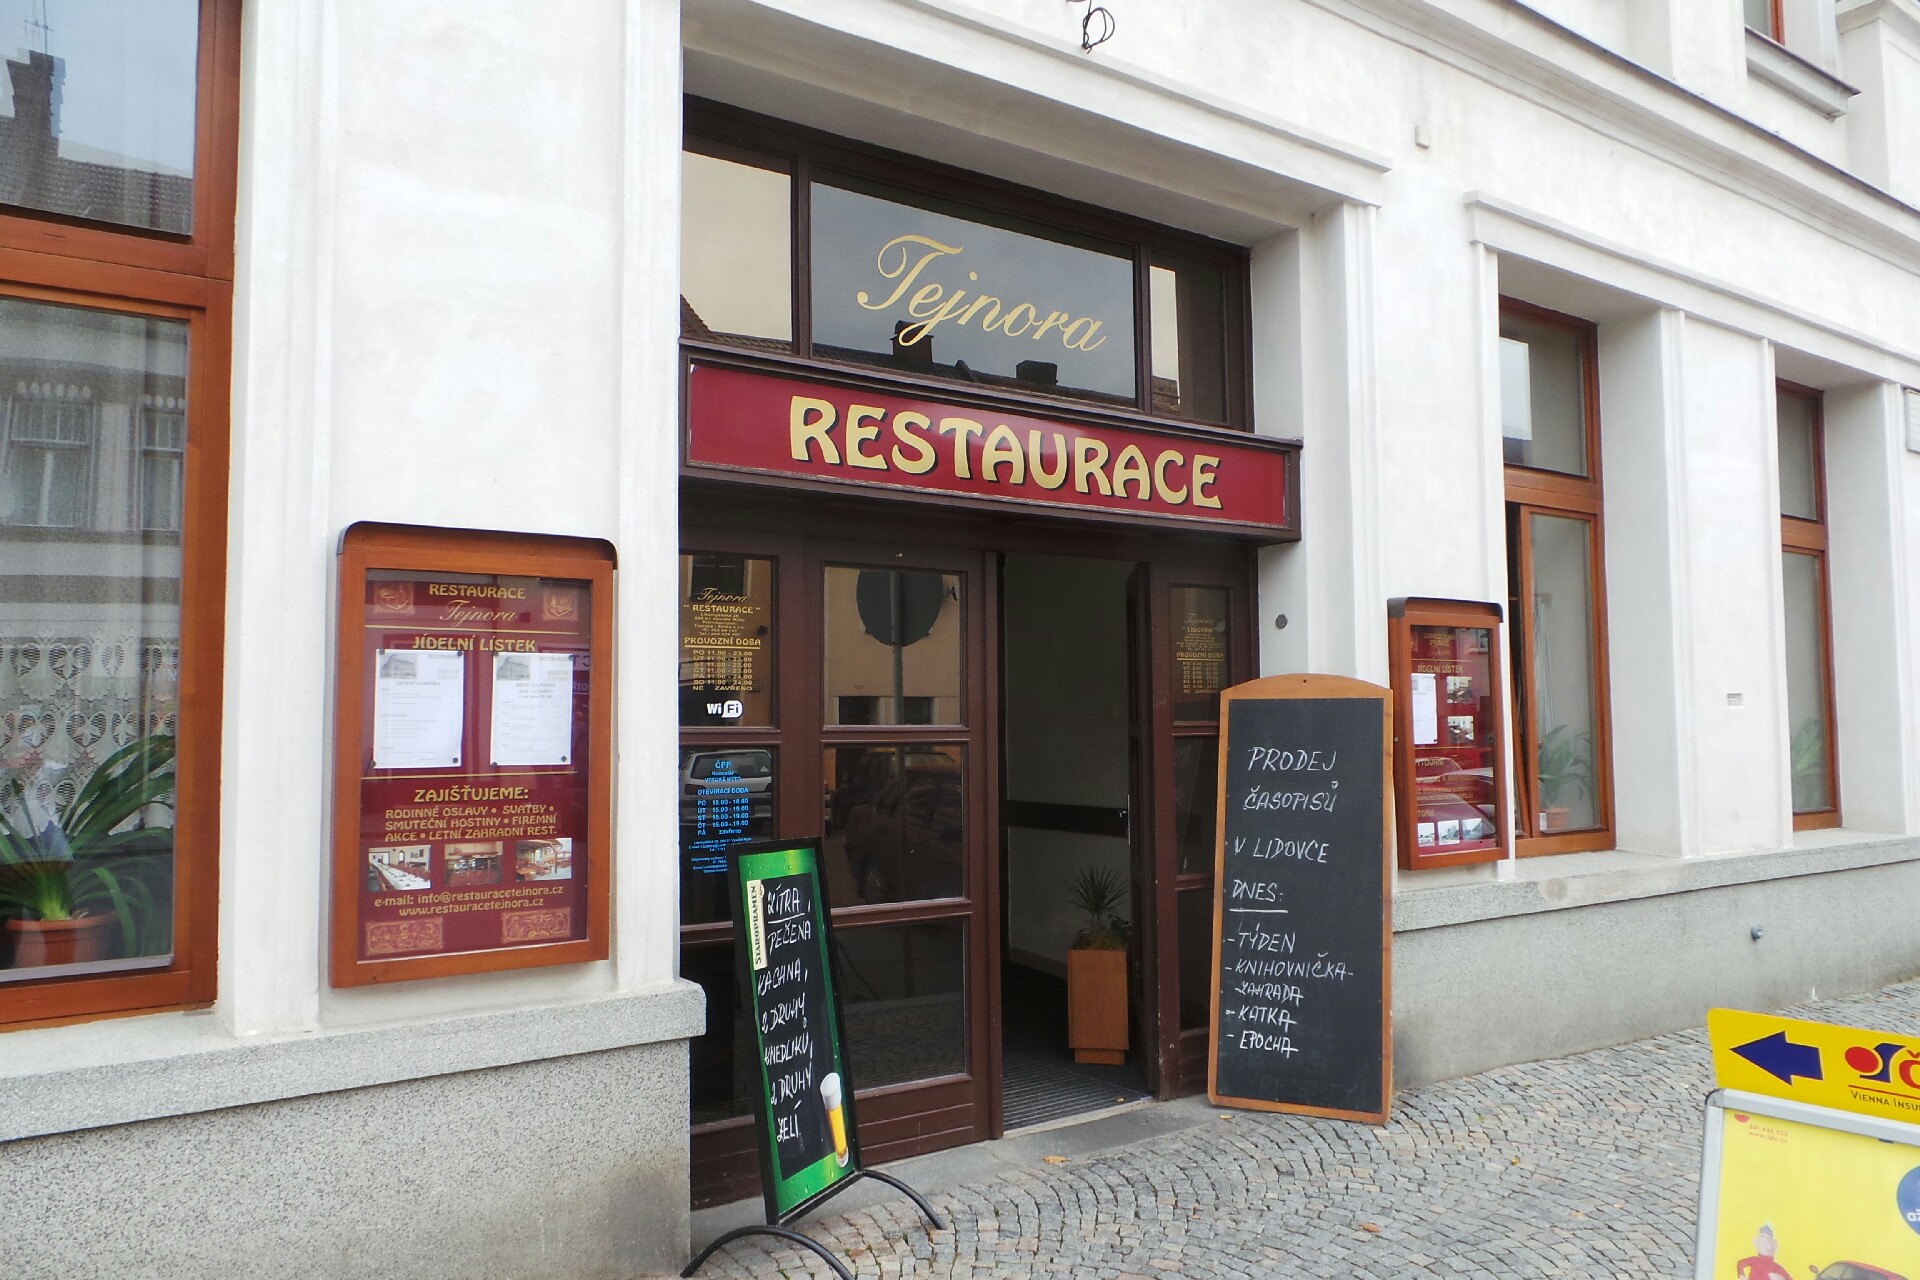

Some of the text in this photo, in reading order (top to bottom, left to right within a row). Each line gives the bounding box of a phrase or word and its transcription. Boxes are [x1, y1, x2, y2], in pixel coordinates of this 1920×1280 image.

[856, 234, 1107, 352] Tejnora
[789, 395, 1223, 510] RESTAURACE
[429, 583, 526, 599] RESTAURACE
[697, 587, 748, 605] Tejnora
[439, 599, 518, 627] Tejnora
[692, 604, 754, 614] RESTAURACE
[412, 634, 536, 653] JÍDELNÍ LÍSTEK
[684, 636, 761, 646] PROVOZNÍ DOBA
[1247, 746, 1337, 772] PRODEJ
[413, 784, 529, 803] ZAJIŠŤUJEME:
[1243, 781, 1339, 813] ČASOPISŮ
[384, 812, 557, 831] SMUTEČNÍ HOSTINY FIREMNÍ
[385, 804, 547, 819] RODINNÉ OSLAVY SVATBY
[384, 824, 557, 842] AKCE LETNÍ ZAHRADNÍ REST.
[1234, 835, 1330, 863] V LIDOVCE
[374, 885, 564, 907] e-mail: info@restauracetejnora.cz
[1232, 879, 1284, 902] DNES:
[399, 897, 544, 917] www.restauracetejnora.cz
[750, 886, 762, 965] STAROPRAMEN
[770, 992, 806, 1031] DRUHY
[778, 1062, 812, 1103] DRUHY
[1851, 1090, 1890, 1107] VIENNA
